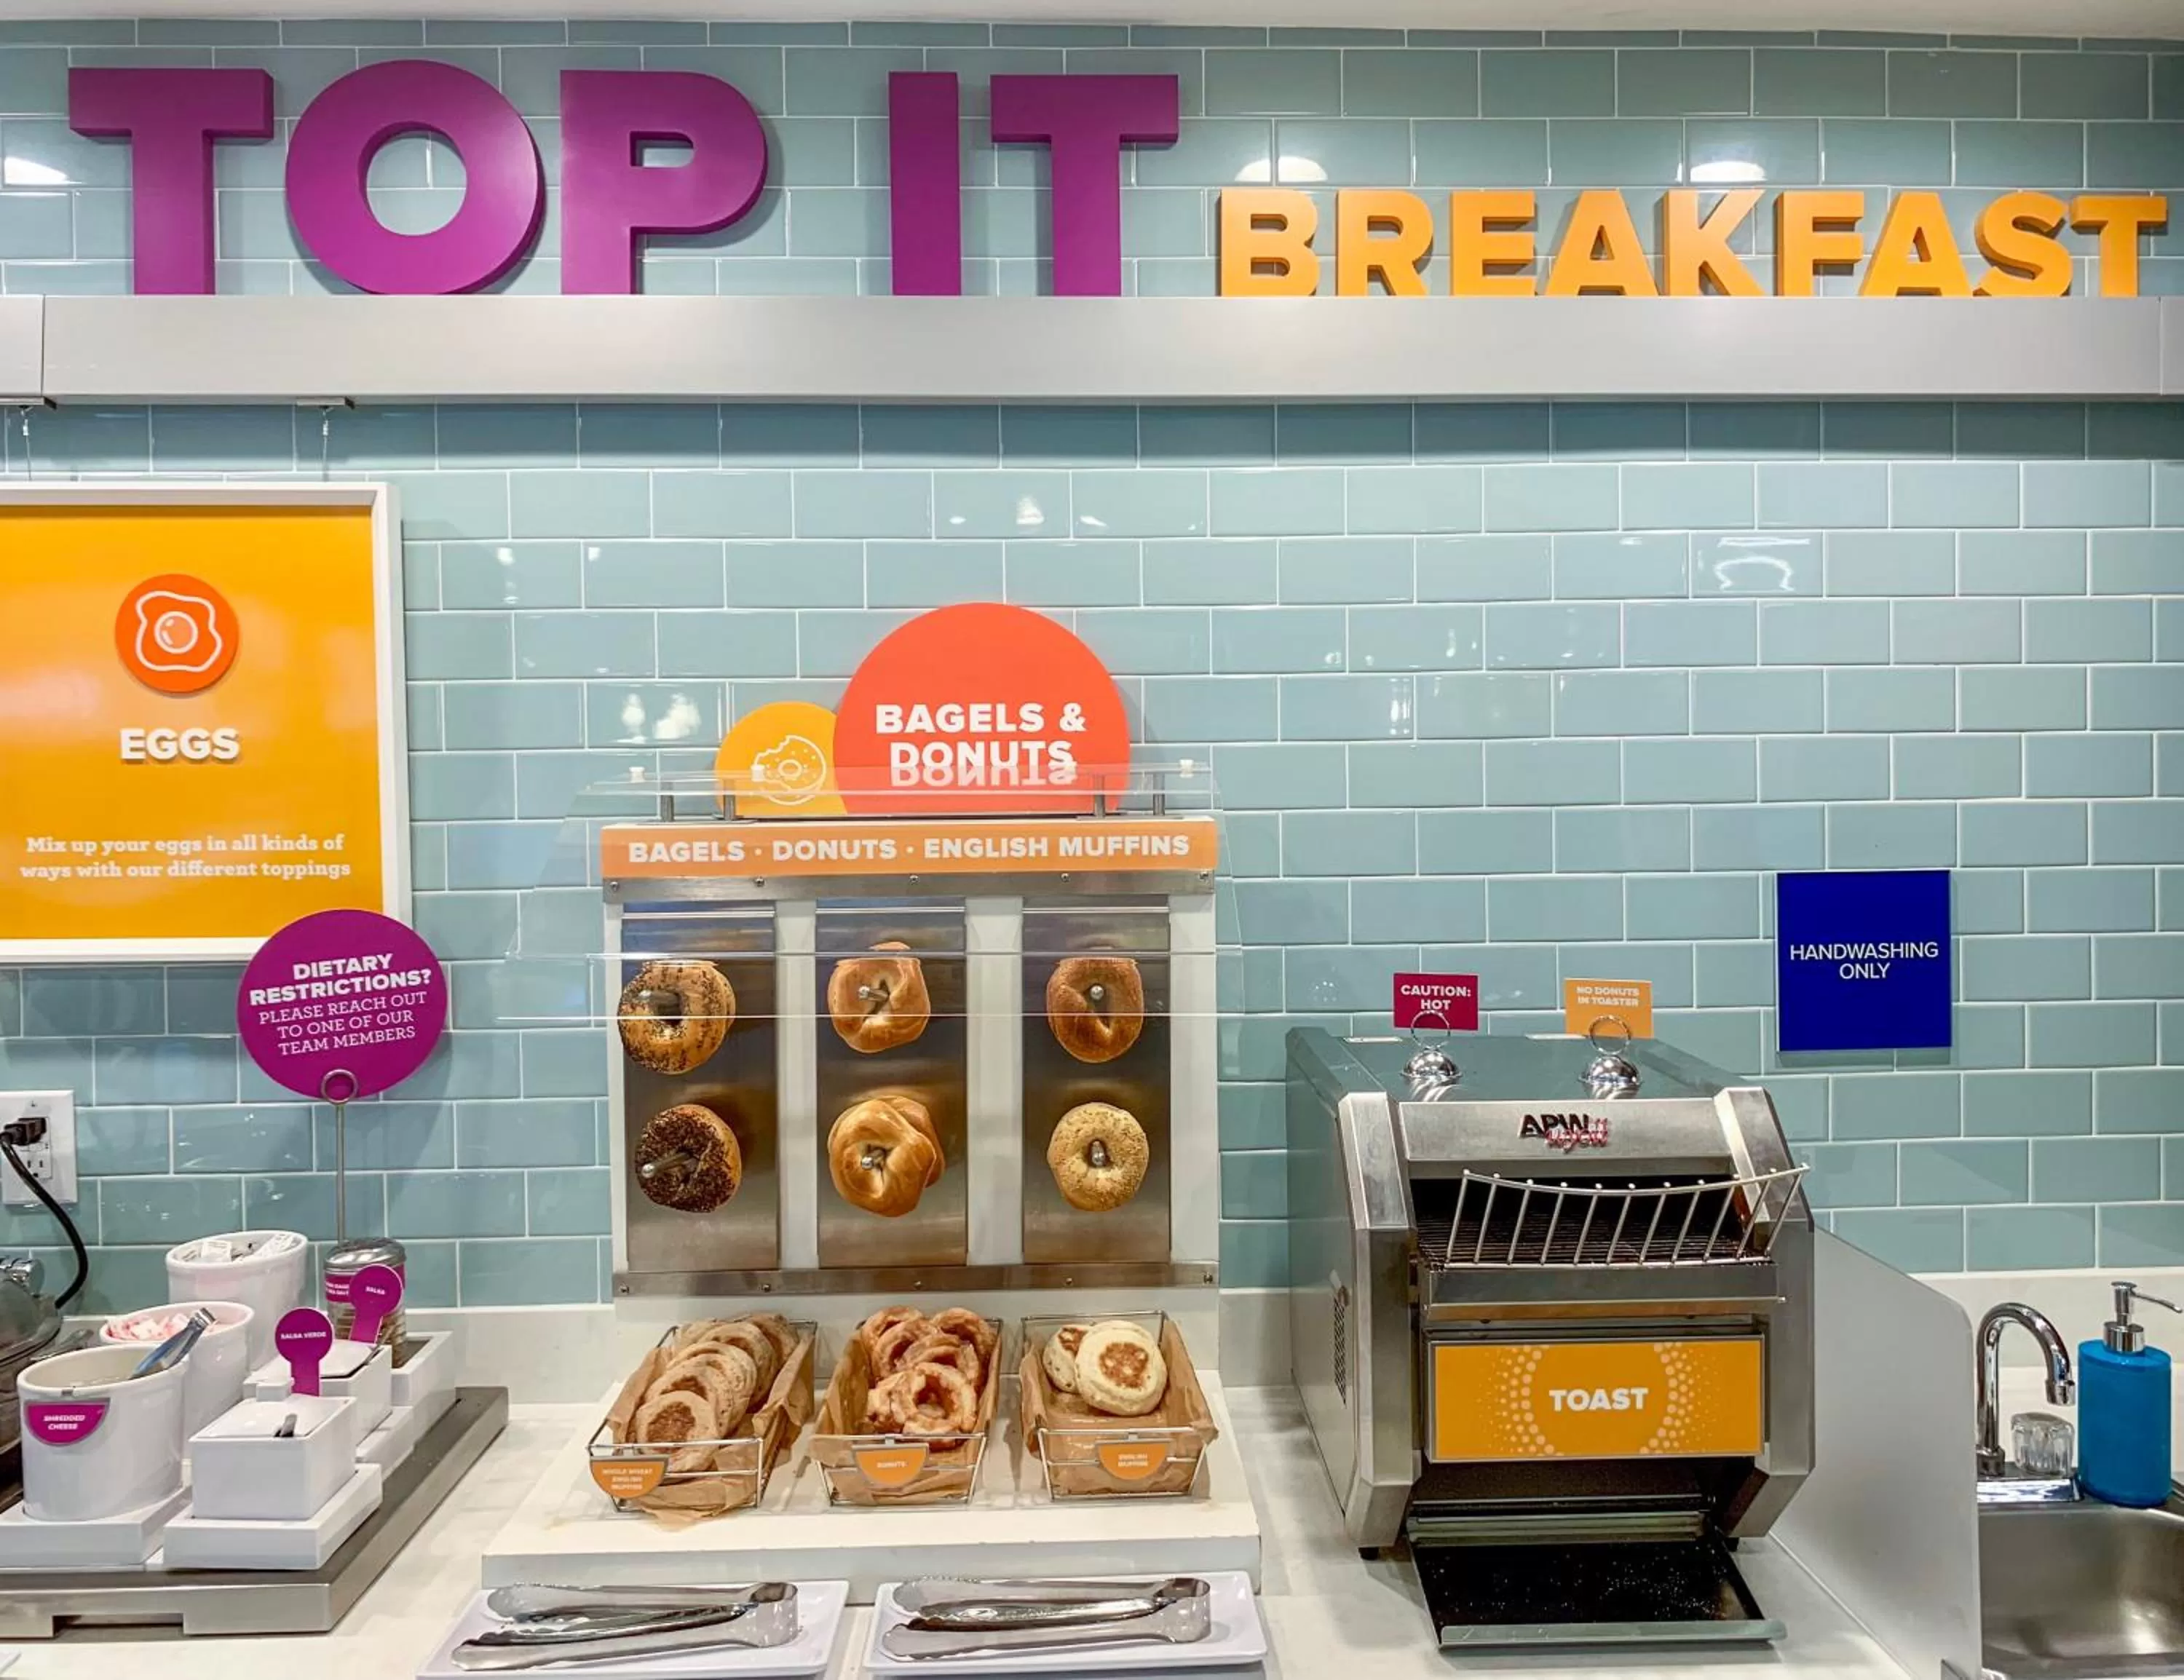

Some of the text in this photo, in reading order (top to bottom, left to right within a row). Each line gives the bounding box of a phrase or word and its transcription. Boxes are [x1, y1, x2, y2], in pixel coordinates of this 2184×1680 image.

[68, 59, 2167, 297] TOP IT BREAKFAST
[876, 701, 1087, 734] BAGELS &
[119, 728, 240, 761] EGGS
[890, 740, 1078, 786] DONUTS
[26, 833, 345, 856] Mix up your eggs in all kinds of
[628, 835, 1189, 863] BAGELS DONUTS ENGLISH MUFFINS
[20, 859, 350, 881] ways with our different toppings
[1789, 941, 1939, 960] HANDWASHING
[293, 953, 393, 980] DIETARY
[1839, 962, 1891, 979] ONLY
[250, 969, 432, 1006] RESTRICTIONS?
[1400, 984, 1471, 997] CAUTION:
[1576, 986, 1639, 996] NO DONUTS
[259, 991, 427, 1024] PLEASE REACH OUT
[1420, 999, 1452, 1010] HOT
[1592, 996, 1639, 1007] TOASTER
[277, 1010, 414, 1039] TO ONE OF OUR
[278, 1026, 416, 1055] TEAM MEMBERS
[1549, 1387, 1649, 1411] TOAST
